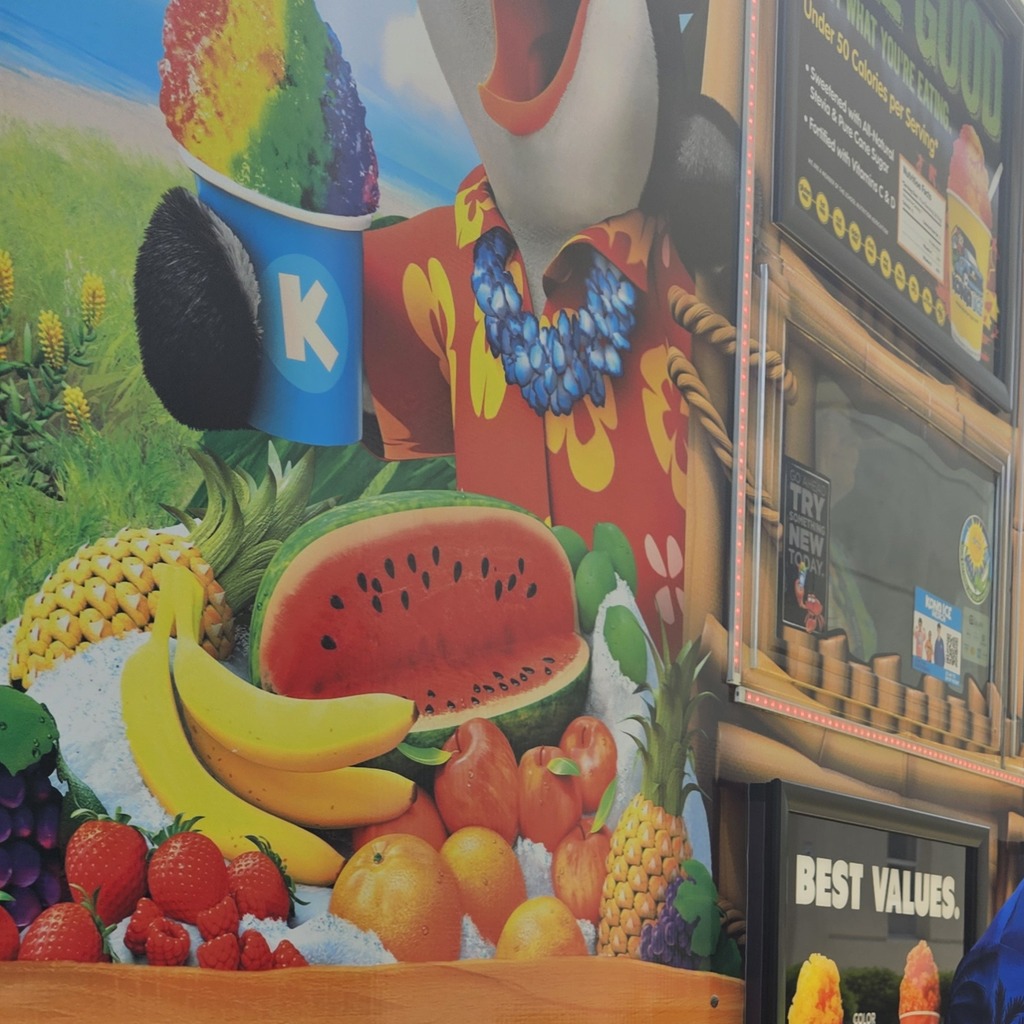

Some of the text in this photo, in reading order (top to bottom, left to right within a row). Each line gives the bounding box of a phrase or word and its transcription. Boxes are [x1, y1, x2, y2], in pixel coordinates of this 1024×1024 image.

[803, 0, 835, 44] Under
[836, 31, 850, 61] 50
[851, 48, 888, 103] Calories
[889, 93, 904, 120] per
[810, 66, 895, 162] Sweetened with All-Natural
[810, 86, 890, 174] Stevia & Pure Cane Sugar
[809, 116, 836, 153] Fortified
[836, 146, 851, 167] with
[851, 157, 878, 193] Vitamins
[878, 184, 884, 199] C
[890, 195, 896, 210] D
[278, 272, 340, 373] K
[788, 510, 826, 537] SOMETHING
[788, 522, 825, 558] NEW
[789, 481, 826, 522] TRY
[795, 854, 961, 921] BEST VALUES.
